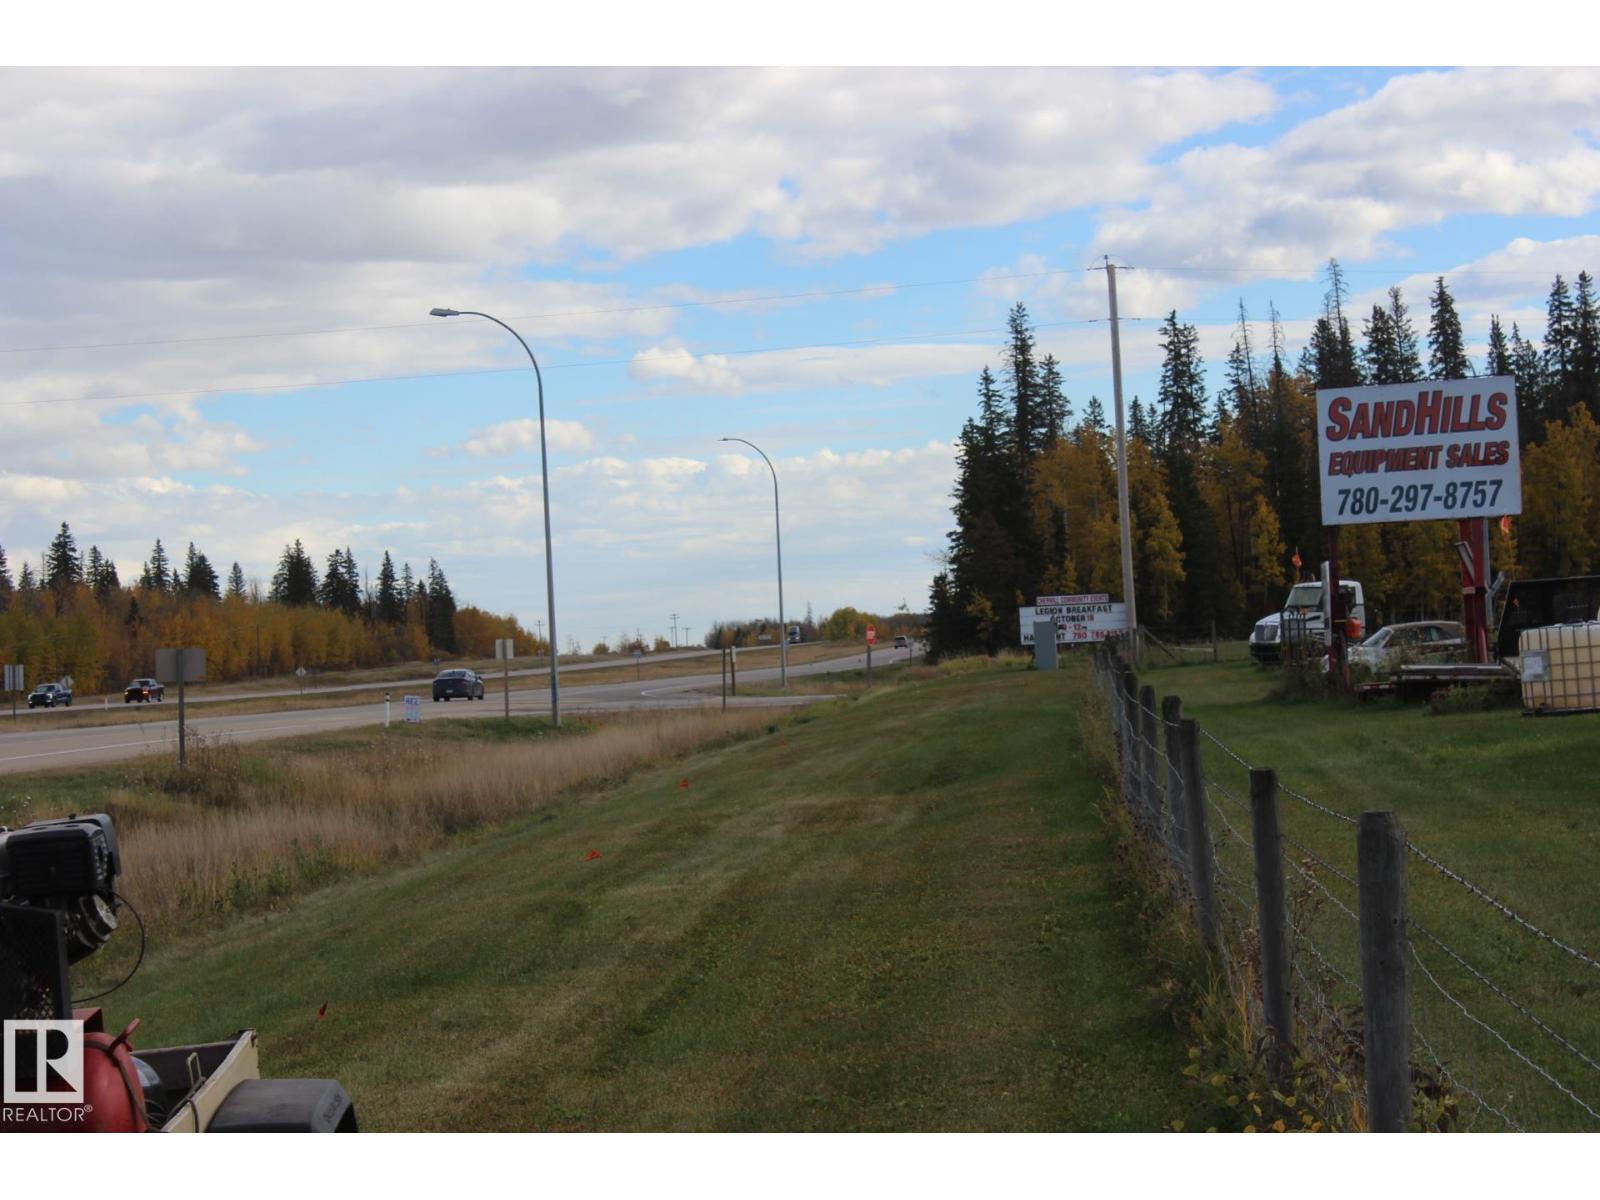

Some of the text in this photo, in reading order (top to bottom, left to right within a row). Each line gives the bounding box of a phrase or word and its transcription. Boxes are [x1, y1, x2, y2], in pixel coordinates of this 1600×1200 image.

[1328, 440, 1510, 477] EQUIPMENT SALES
[1338, 479, 1503, 516] 780-297-8757
[1035, 605, 1112, 615] LEGION BREAKFAST
